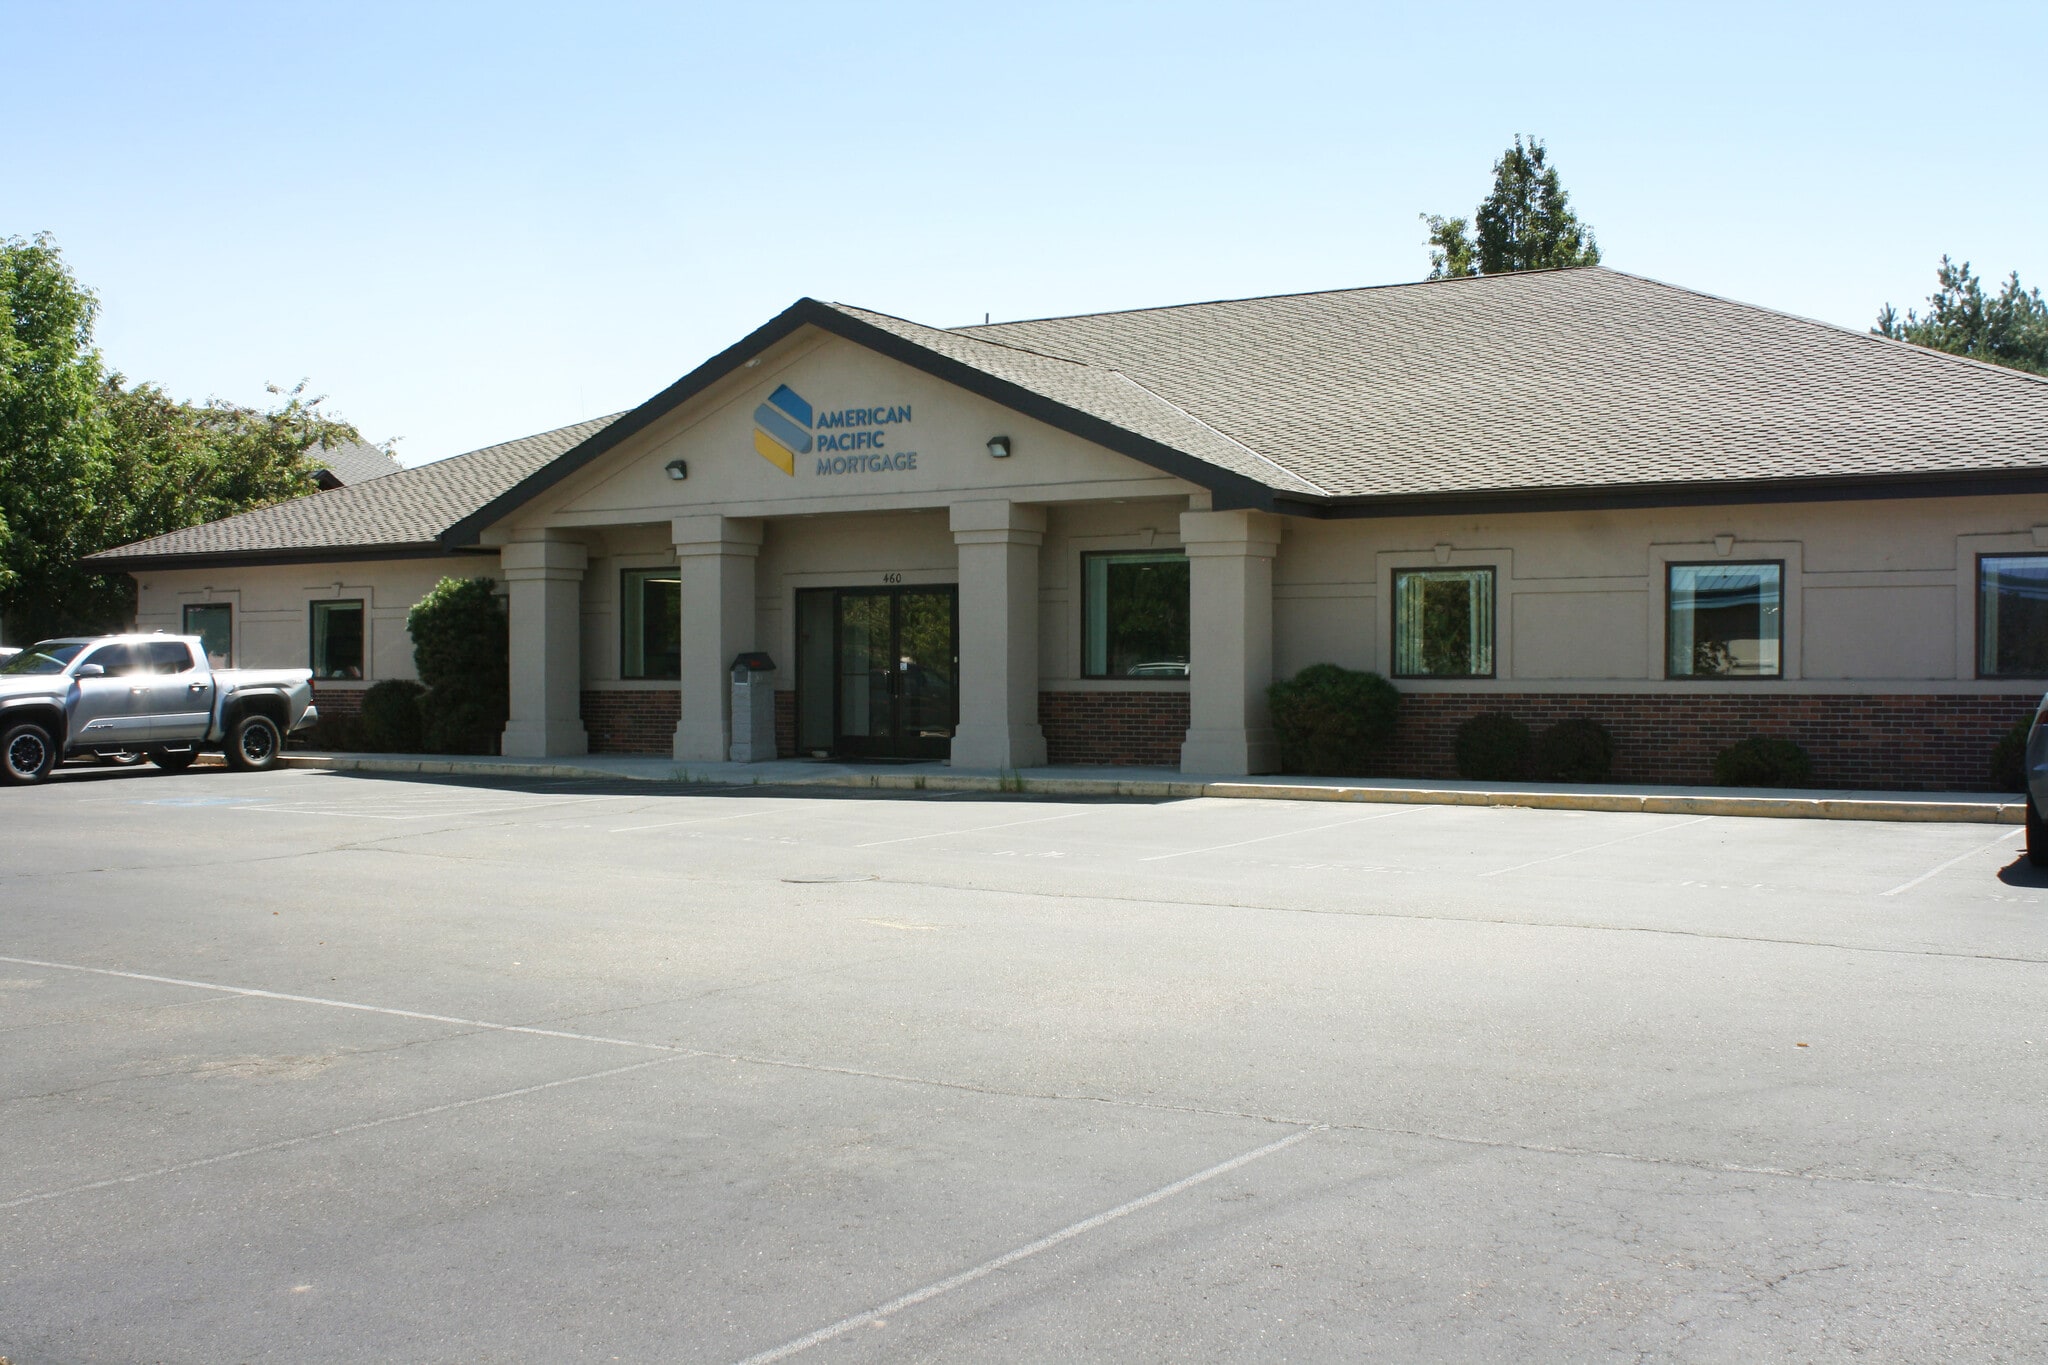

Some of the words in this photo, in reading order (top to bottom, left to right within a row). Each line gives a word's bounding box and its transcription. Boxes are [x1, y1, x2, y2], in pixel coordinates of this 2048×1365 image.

[816, 405, 912, 429] AMERICAN
[817, 430, 885, 452] PACIFIC
[816, 452, 917, 475] MORTGAGE
[883, 573, 901, 583] 460
